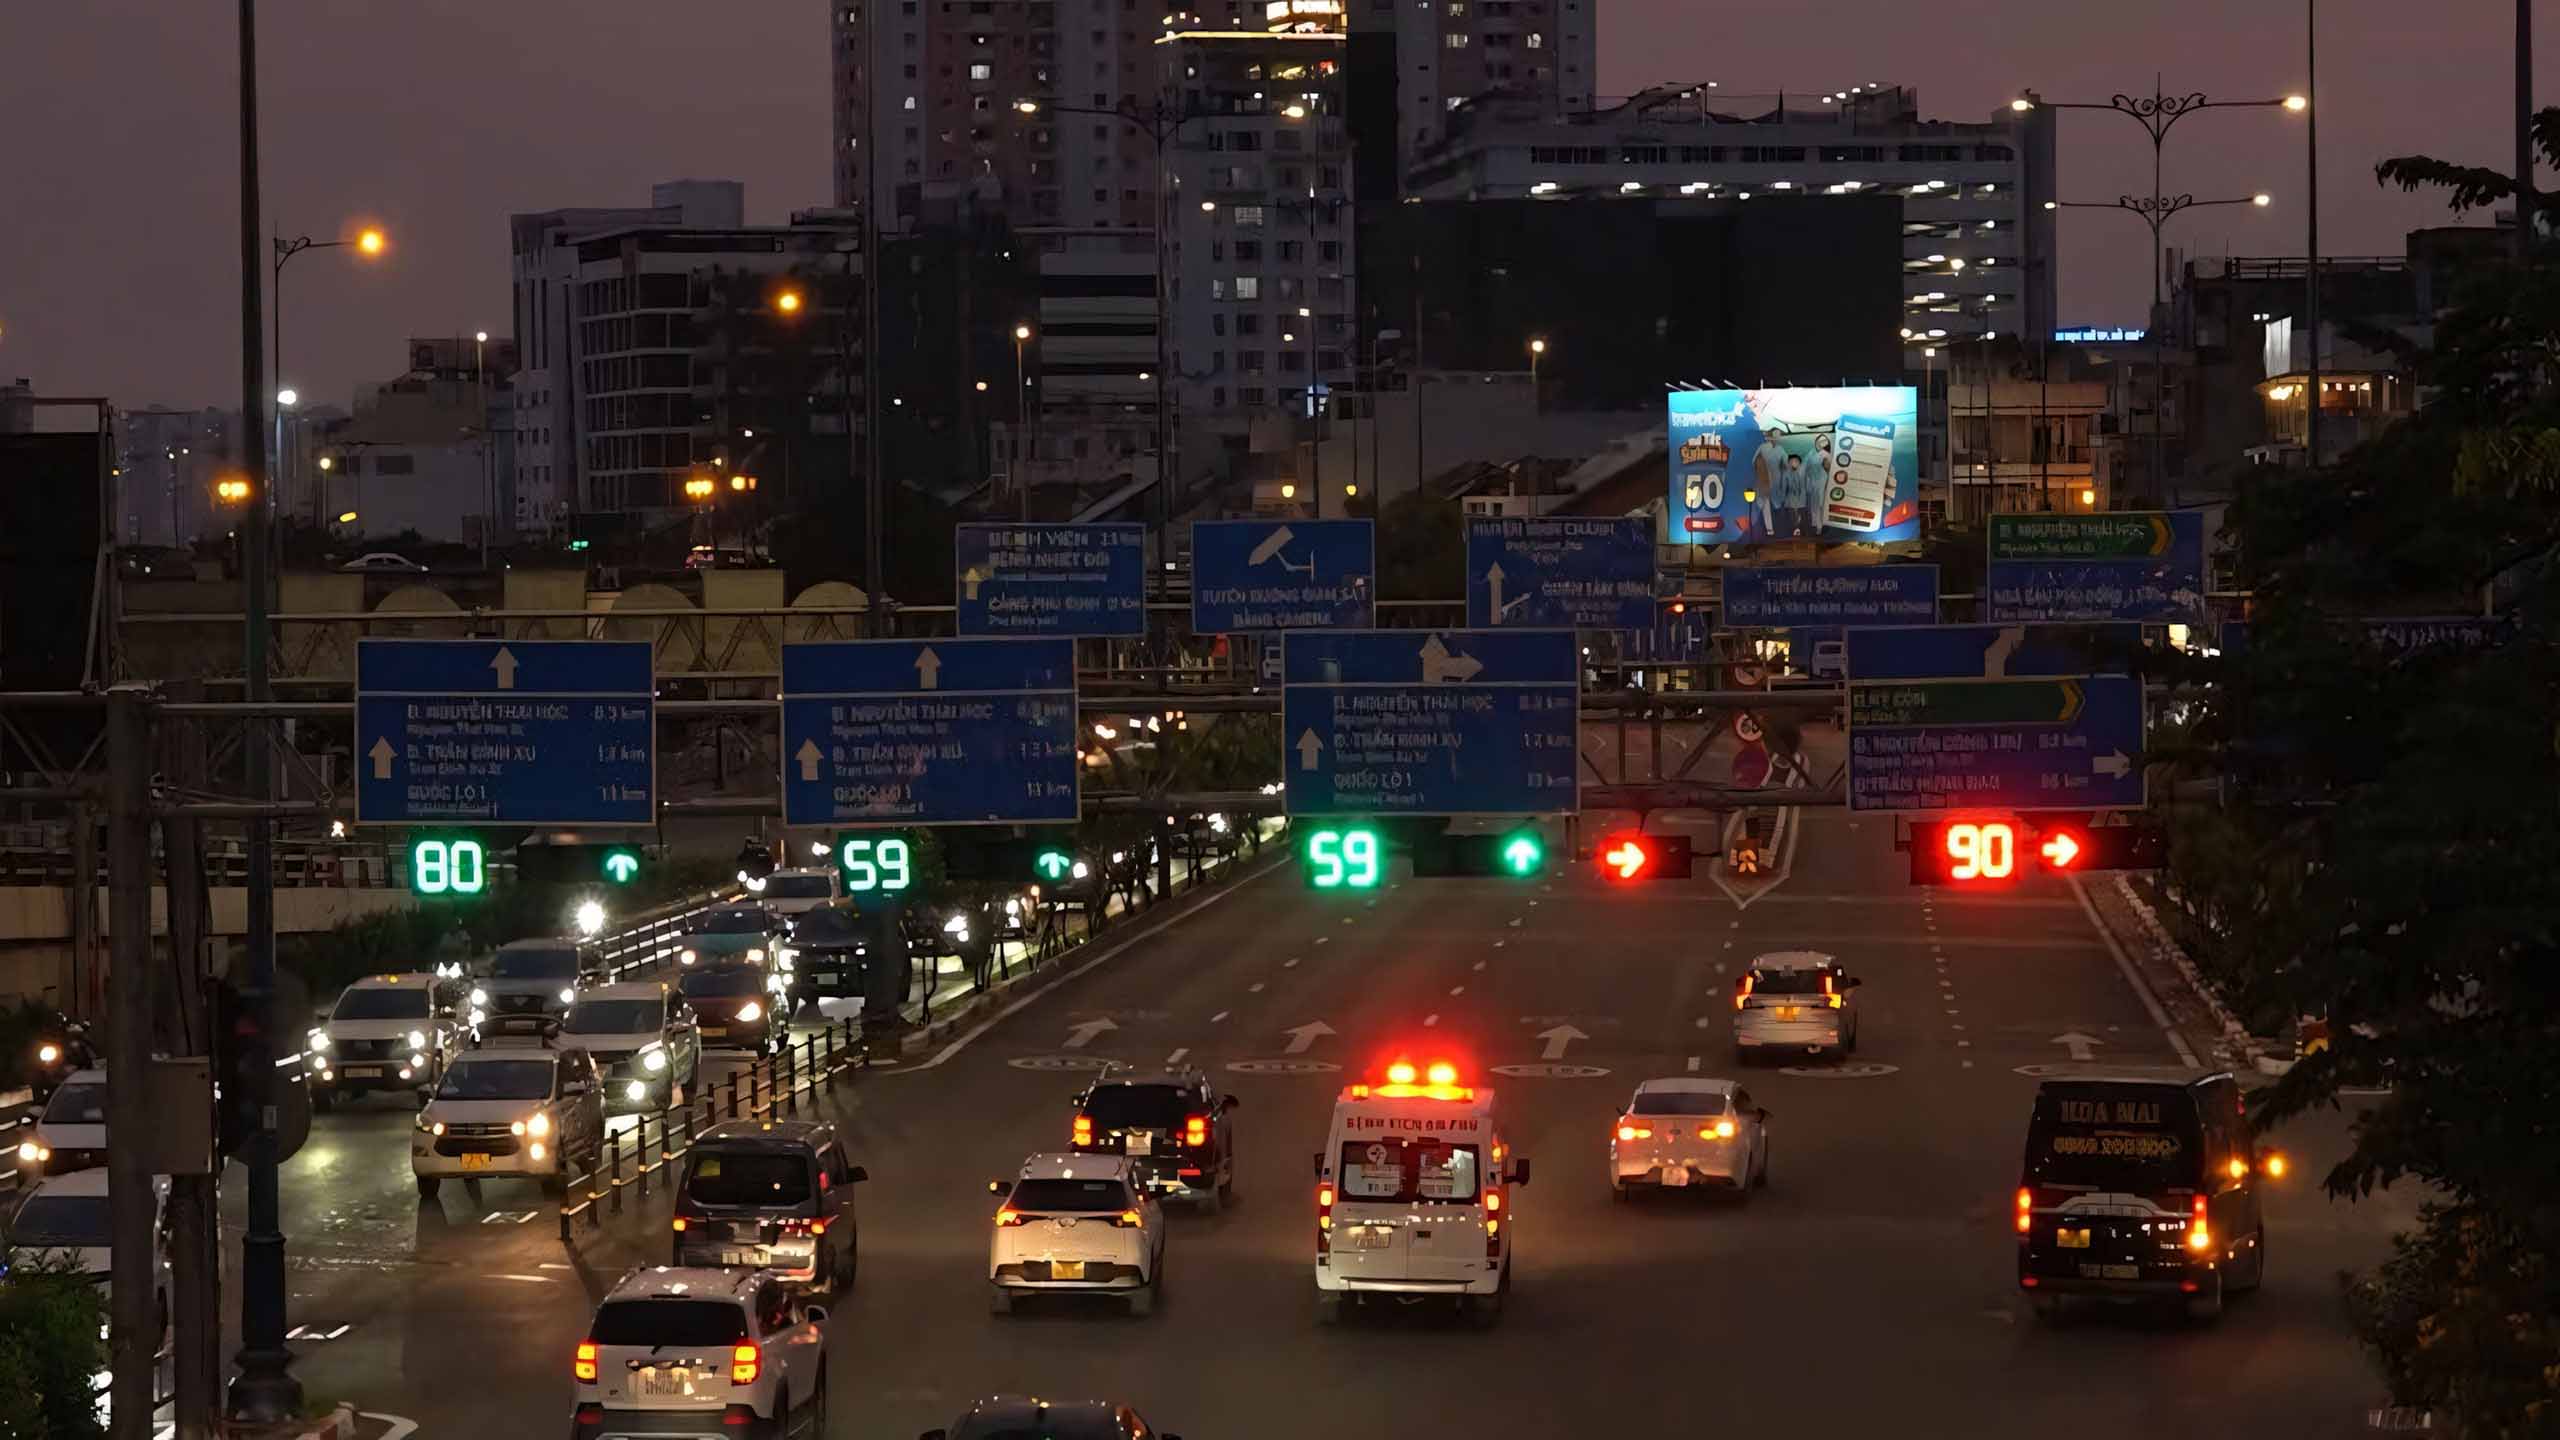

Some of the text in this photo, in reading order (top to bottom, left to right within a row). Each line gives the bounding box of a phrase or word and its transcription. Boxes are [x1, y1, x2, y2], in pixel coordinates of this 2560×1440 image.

[416, 840, 483, 893] 80
[844, 839, 911, 891] 59
[1309, 830, 1378, 887] 59
[1947, 823, 2014, 879] 90
